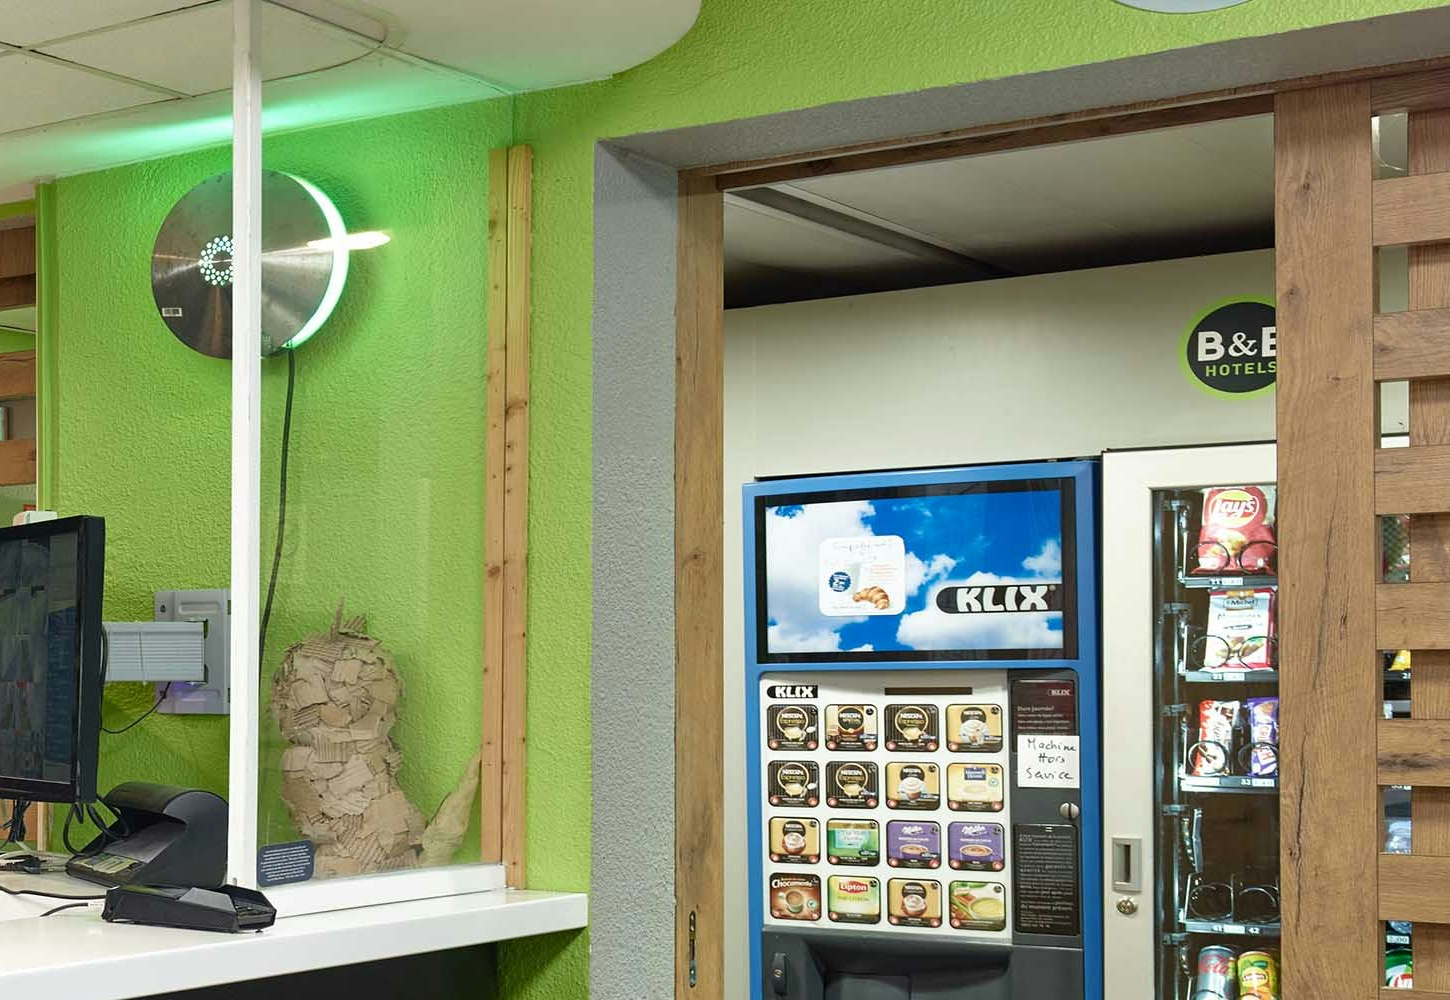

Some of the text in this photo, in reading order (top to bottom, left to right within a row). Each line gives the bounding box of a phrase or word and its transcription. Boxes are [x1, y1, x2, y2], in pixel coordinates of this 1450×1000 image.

[1205, 362, 1277, 377] HOTELS
[955, 585, 1050, 613] KLIX
[775, 685, 814, 698] KLIX
[1037, 752, 1066, 764] Hors
[839, 883, 867, 893] Lipton
